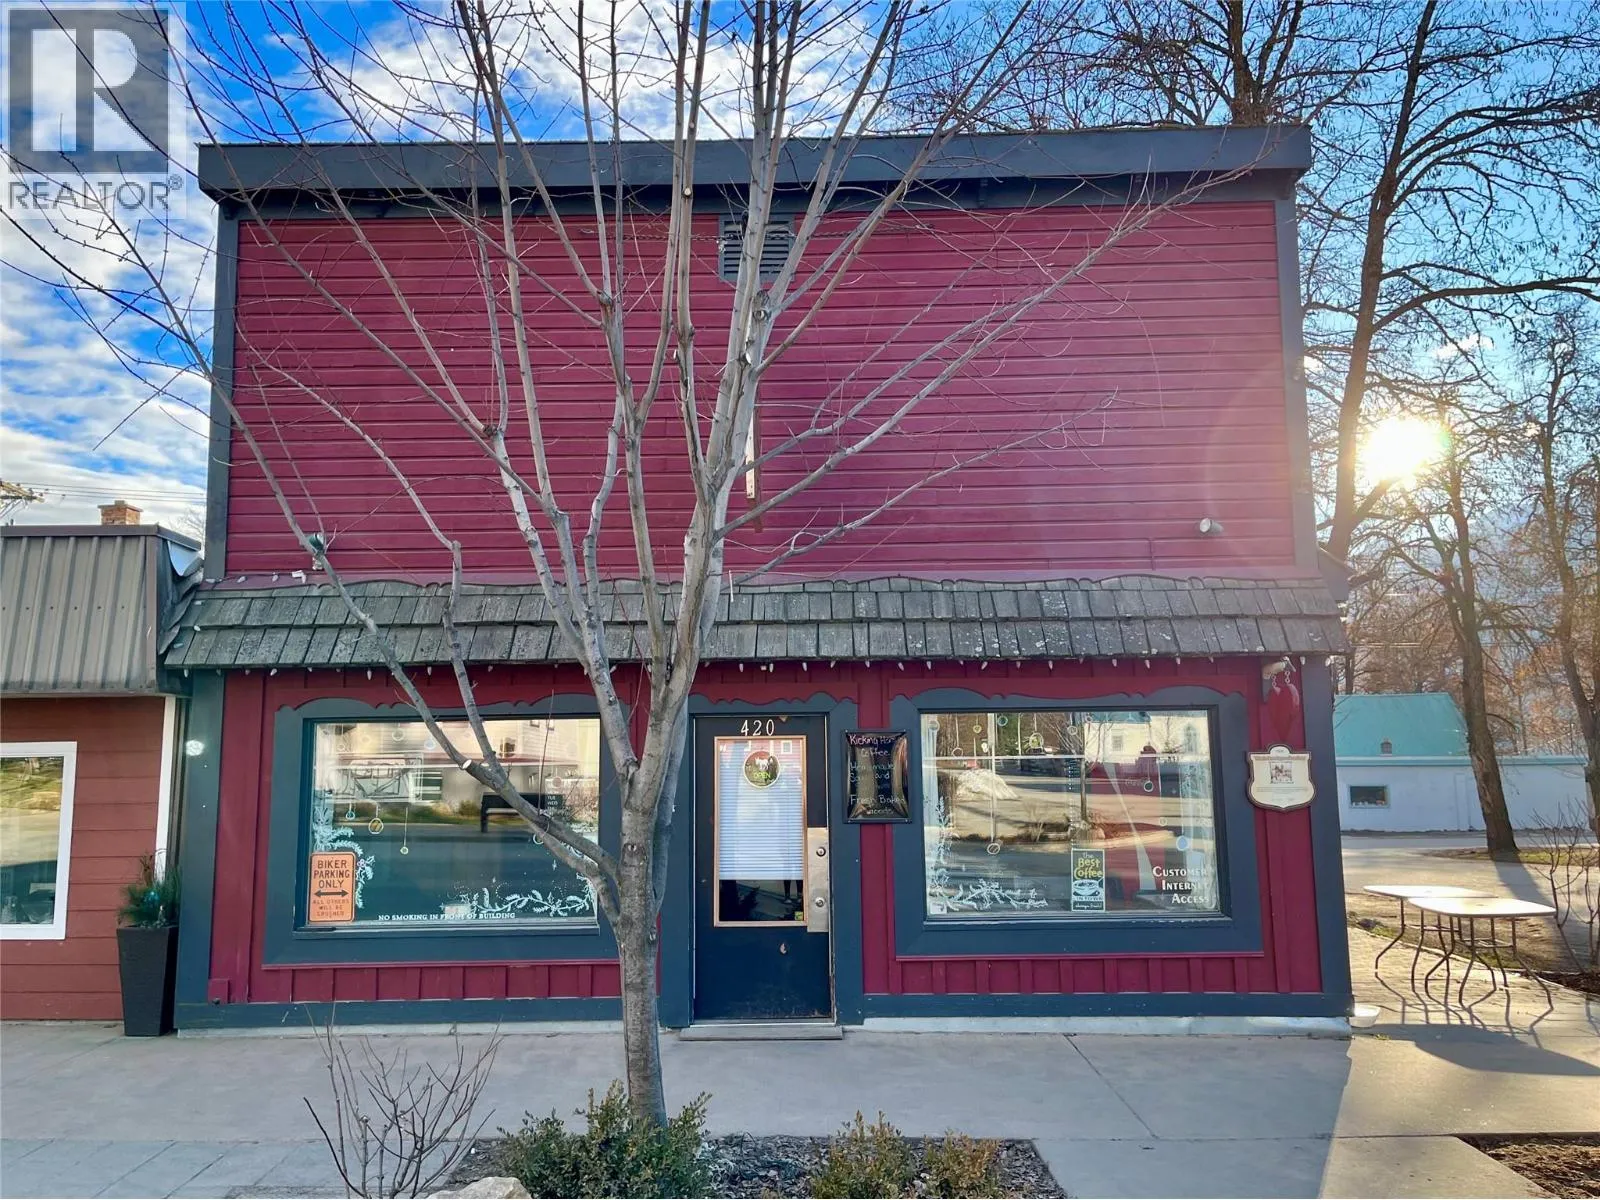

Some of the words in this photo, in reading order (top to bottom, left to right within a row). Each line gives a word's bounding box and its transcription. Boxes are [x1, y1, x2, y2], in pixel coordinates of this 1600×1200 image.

[740, 719, 775, 736] 420
[849, 734, 879, 749] Kicking
[753, 771, 771, 779] OPEN
[317, 859, 347, 869] BIKER
[1078, 857, 1100, 868] Best
[313, 869, 350, 879] PARKING
[1074, 866, 1103, 879] Coffee
[318, 879, 344, 889] ONLY
